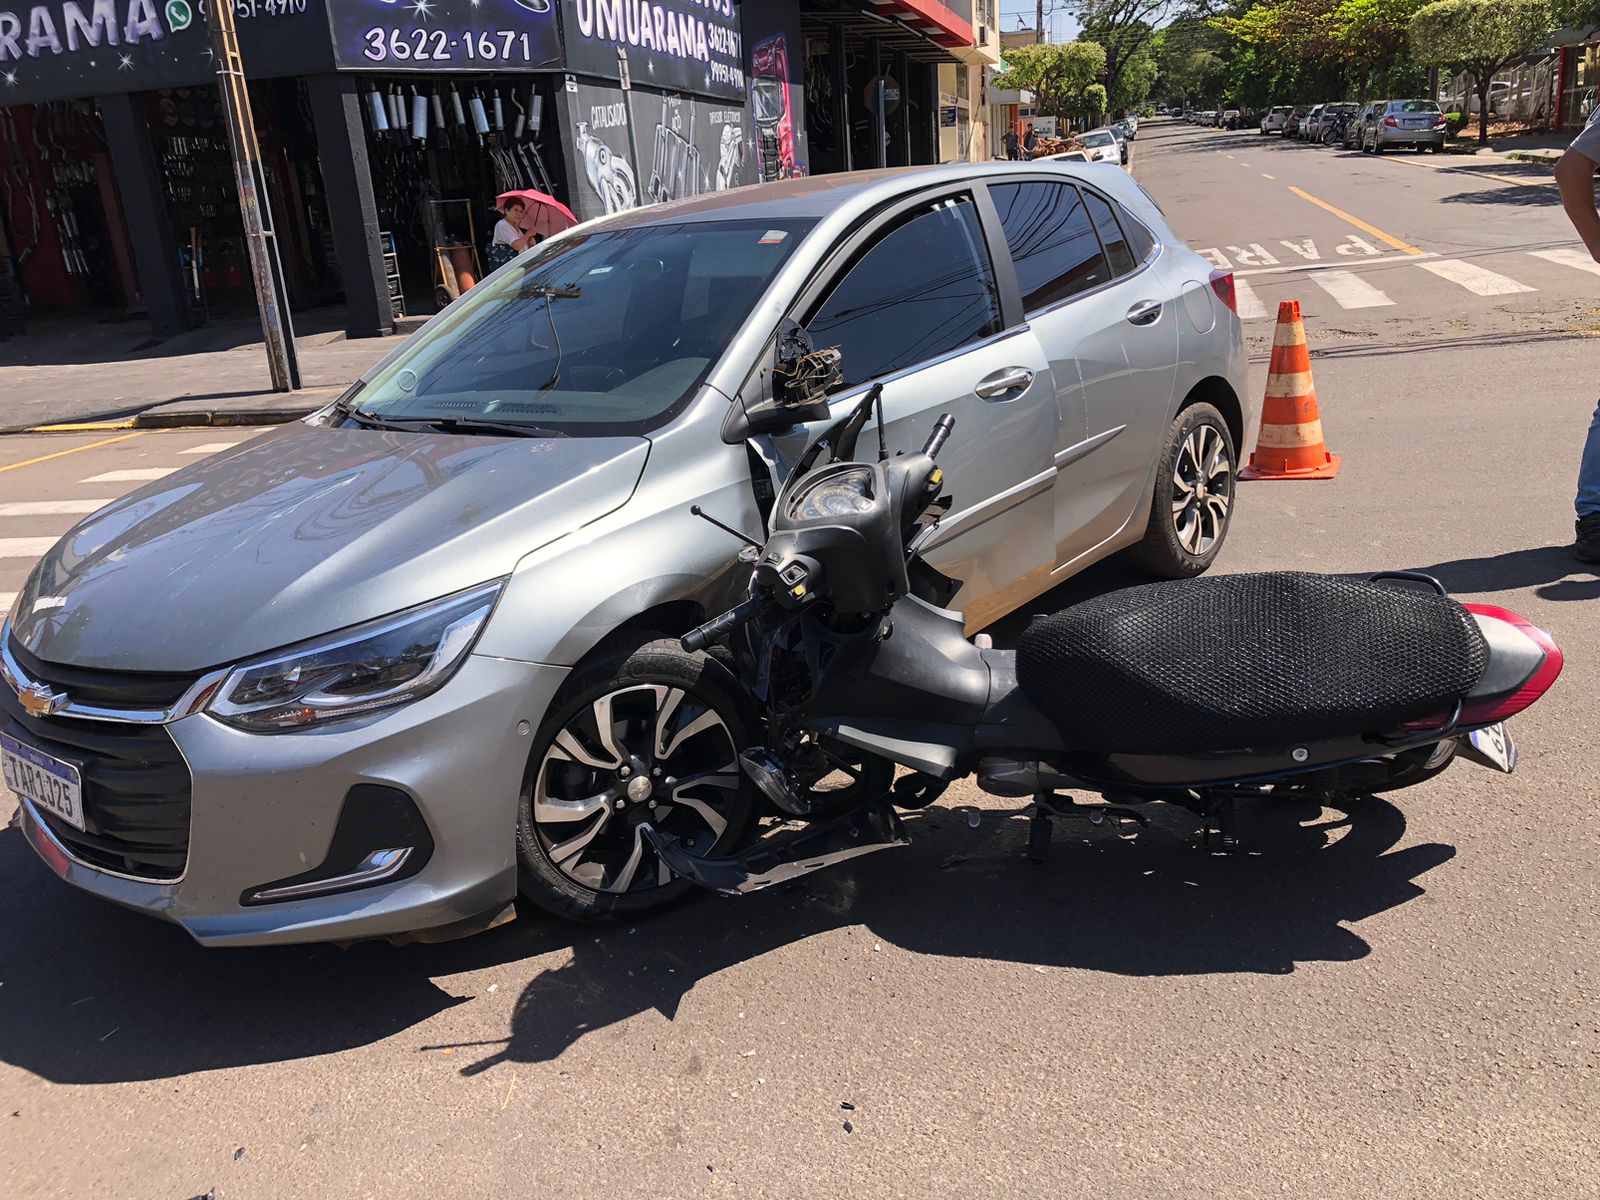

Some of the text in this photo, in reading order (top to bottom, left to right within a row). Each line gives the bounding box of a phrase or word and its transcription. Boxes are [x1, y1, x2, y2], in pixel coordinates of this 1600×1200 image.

[364, 27, 530, 61] 3622-1671
[576, 0, 710, 62] UMUARAMA
[591, 103, 628, 130] CATALISADO
[1194, 234, 1382, 270] PARE
[9, 756, 73, 818] TAR1J25
